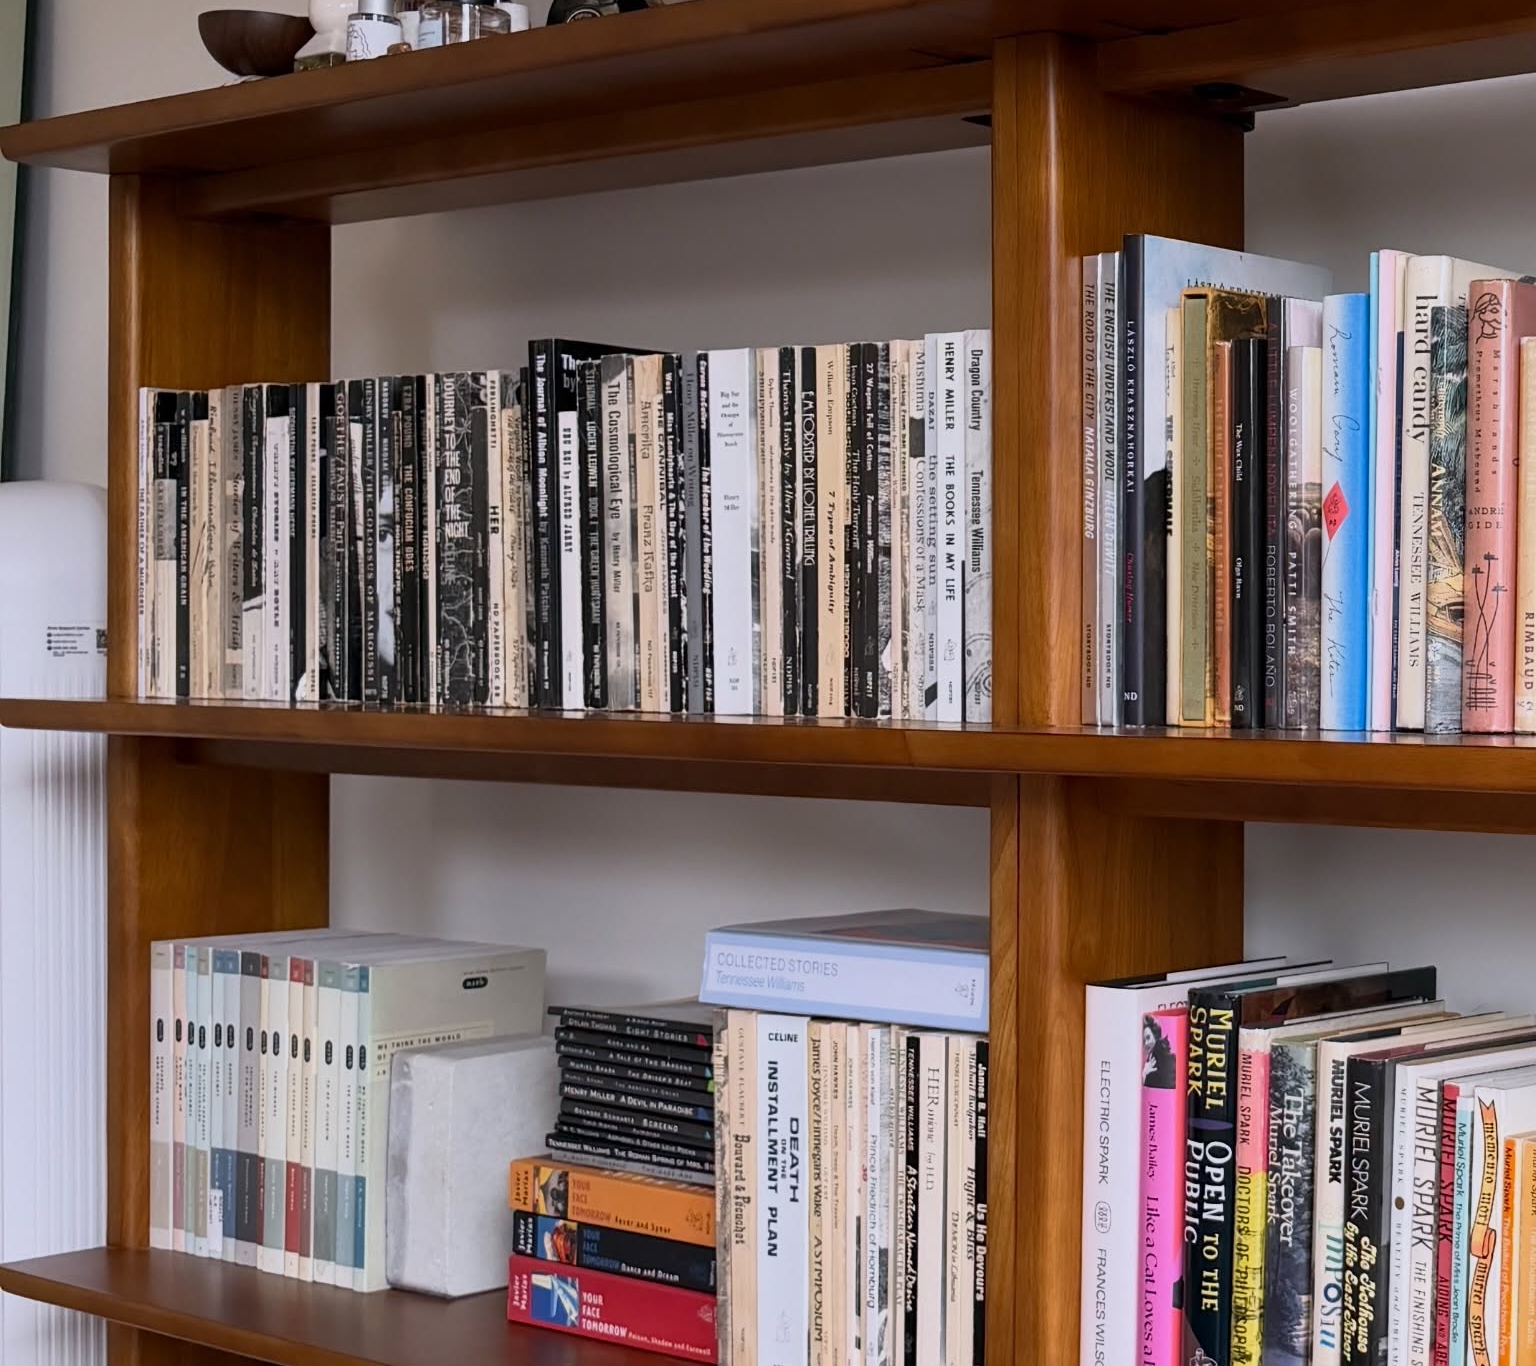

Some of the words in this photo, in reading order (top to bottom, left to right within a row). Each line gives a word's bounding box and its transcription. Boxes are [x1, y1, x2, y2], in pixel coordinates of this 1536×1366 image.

[1085, 284, 1095, 306] THE
[1085, 311, 1095, 339] ROAD
[1414, 295, 1438, 355] hard
[536, 354, 545, 371] The
[945, 343, 954, 381] HENRY
[1085, 344, 1095, 359] TO
[1127, 321, 1136, 372] LÁSZLÓ
[970, 349, 983, 386] Dragon
[1085, 364, 1095, 387] THE
[444, 378, 455, 432] JOURNEY
[537, 377, 546, 412] Journal
[608, 382, 619, 406] The
[945, 390, 954, 430] MILLER
[969, 390, 983, 430] Country
[1085, 393, 1095, 419] CITY
[1406, 367, 1431, 444] candy
[538, 417, 547, 428] of
[1127, 379, 1135, 493] KRASZNAHORKAI
[539, 432, 547, 463] Albion
[608, 411, 621, 492] Cosmological
[1085, 427, 1095, 475] NATALIA
[945, 456, 954, 477] THE
[539, 468, 549, 517] Moonlight
[609, 497, 621, 519] Eye
[945, 484, 954, 526] BOOKS
[971, 470, 983, 524] Tennessee
[1085, 480, 1095, 538] GINZBURG
[945, 534, 954, 544] IN
[971, 528, 983, 572] Williams
[1410, 492, 1424, 583] TENNESSEE
[945, 554, 954, 570] MY
[945, 579, 954, 600] LIFE
[1408, 592, 1421, 667] WILLIAMS
[717, 953, 787, 971] COLLECTED
[790, 957, 838, 976] STORIES
[1099, 1061, 1111, 1130] ELECTRIC
[767, 1061, 778, 1193] INSTALLMENT
[788, 1117, 799, 1203] DEATH
[1098, 1135, 1110, 1184] SPARK
[767, 1207, 777, 1256] PLAN
[1144, 1196, 1159, 1232] Like
[1145, 1237, 1155, 1248] a
[1202, 1233, 1219, 1259] TO
[1094, 1249, 1107, 1320] FRANCES
[1144, 1252, 1158, 1285] Cat
[583, 1292, 603, 1306] YOUR
[1201, 1269, 1219, 1310] THE
[582, 1318, 627, 1337] TOMORROW
[583, 1306, 601, 1319] FACE
[1143, 1289, 1158, 1339] Loves
[1143, 1343, 1154, 1356] a
